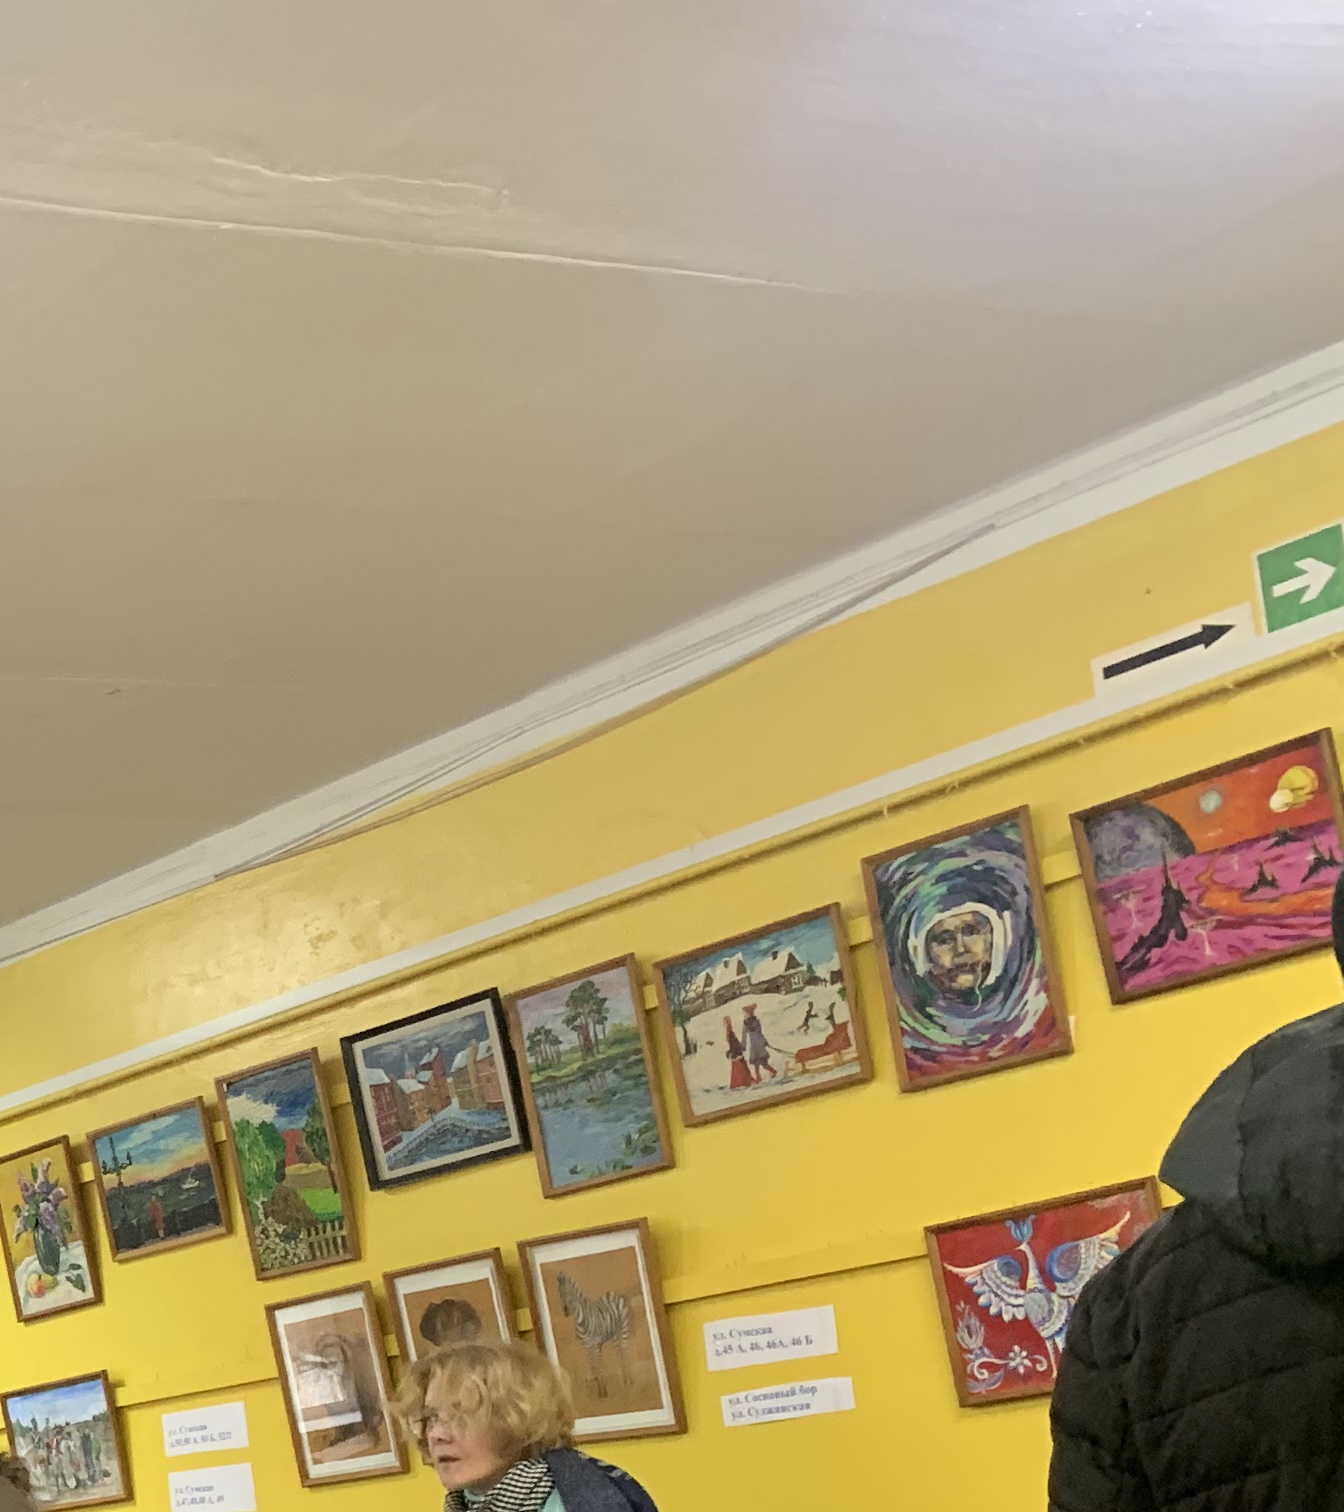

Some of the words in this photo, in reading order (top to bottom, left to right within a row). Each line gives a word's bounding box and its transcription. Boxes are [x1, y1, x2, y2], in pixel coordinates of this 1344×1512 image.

[744, 1386, 796, 1403] Сосновый
[799, 1385, 818, 1396] бор
[731, 1410, 745, 1421] ул.
